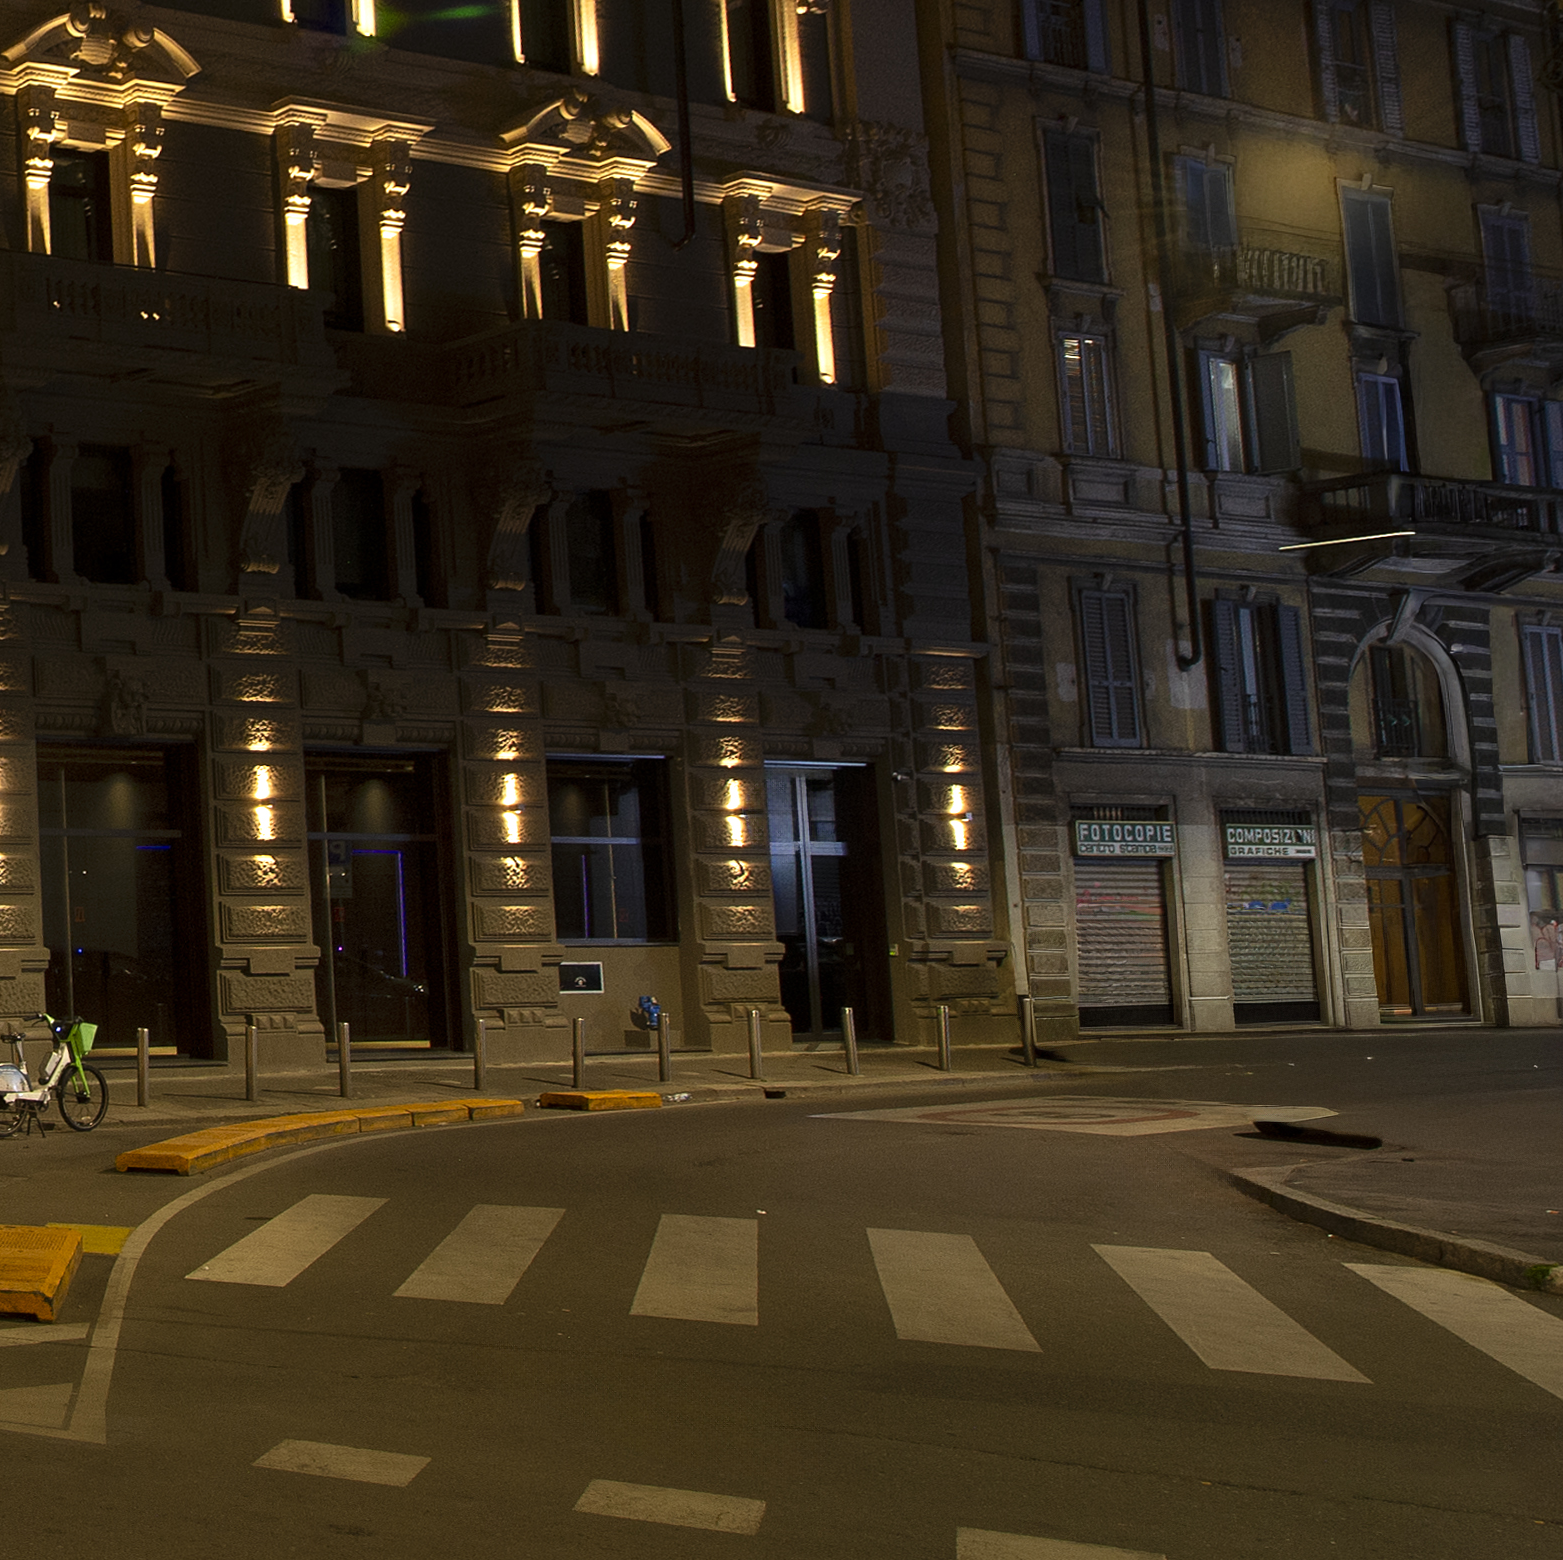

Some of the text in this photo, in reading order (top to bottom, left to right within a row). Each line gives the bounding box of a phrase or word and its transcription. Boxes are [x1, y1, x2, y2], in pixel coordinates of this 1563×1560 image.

[1078, 824, 1172, 842] FOTOCOPIE
[1227, 828, 1316, 844] COMPOSIZINI
[1229, 847, 1290, 856] GRAFICHE
